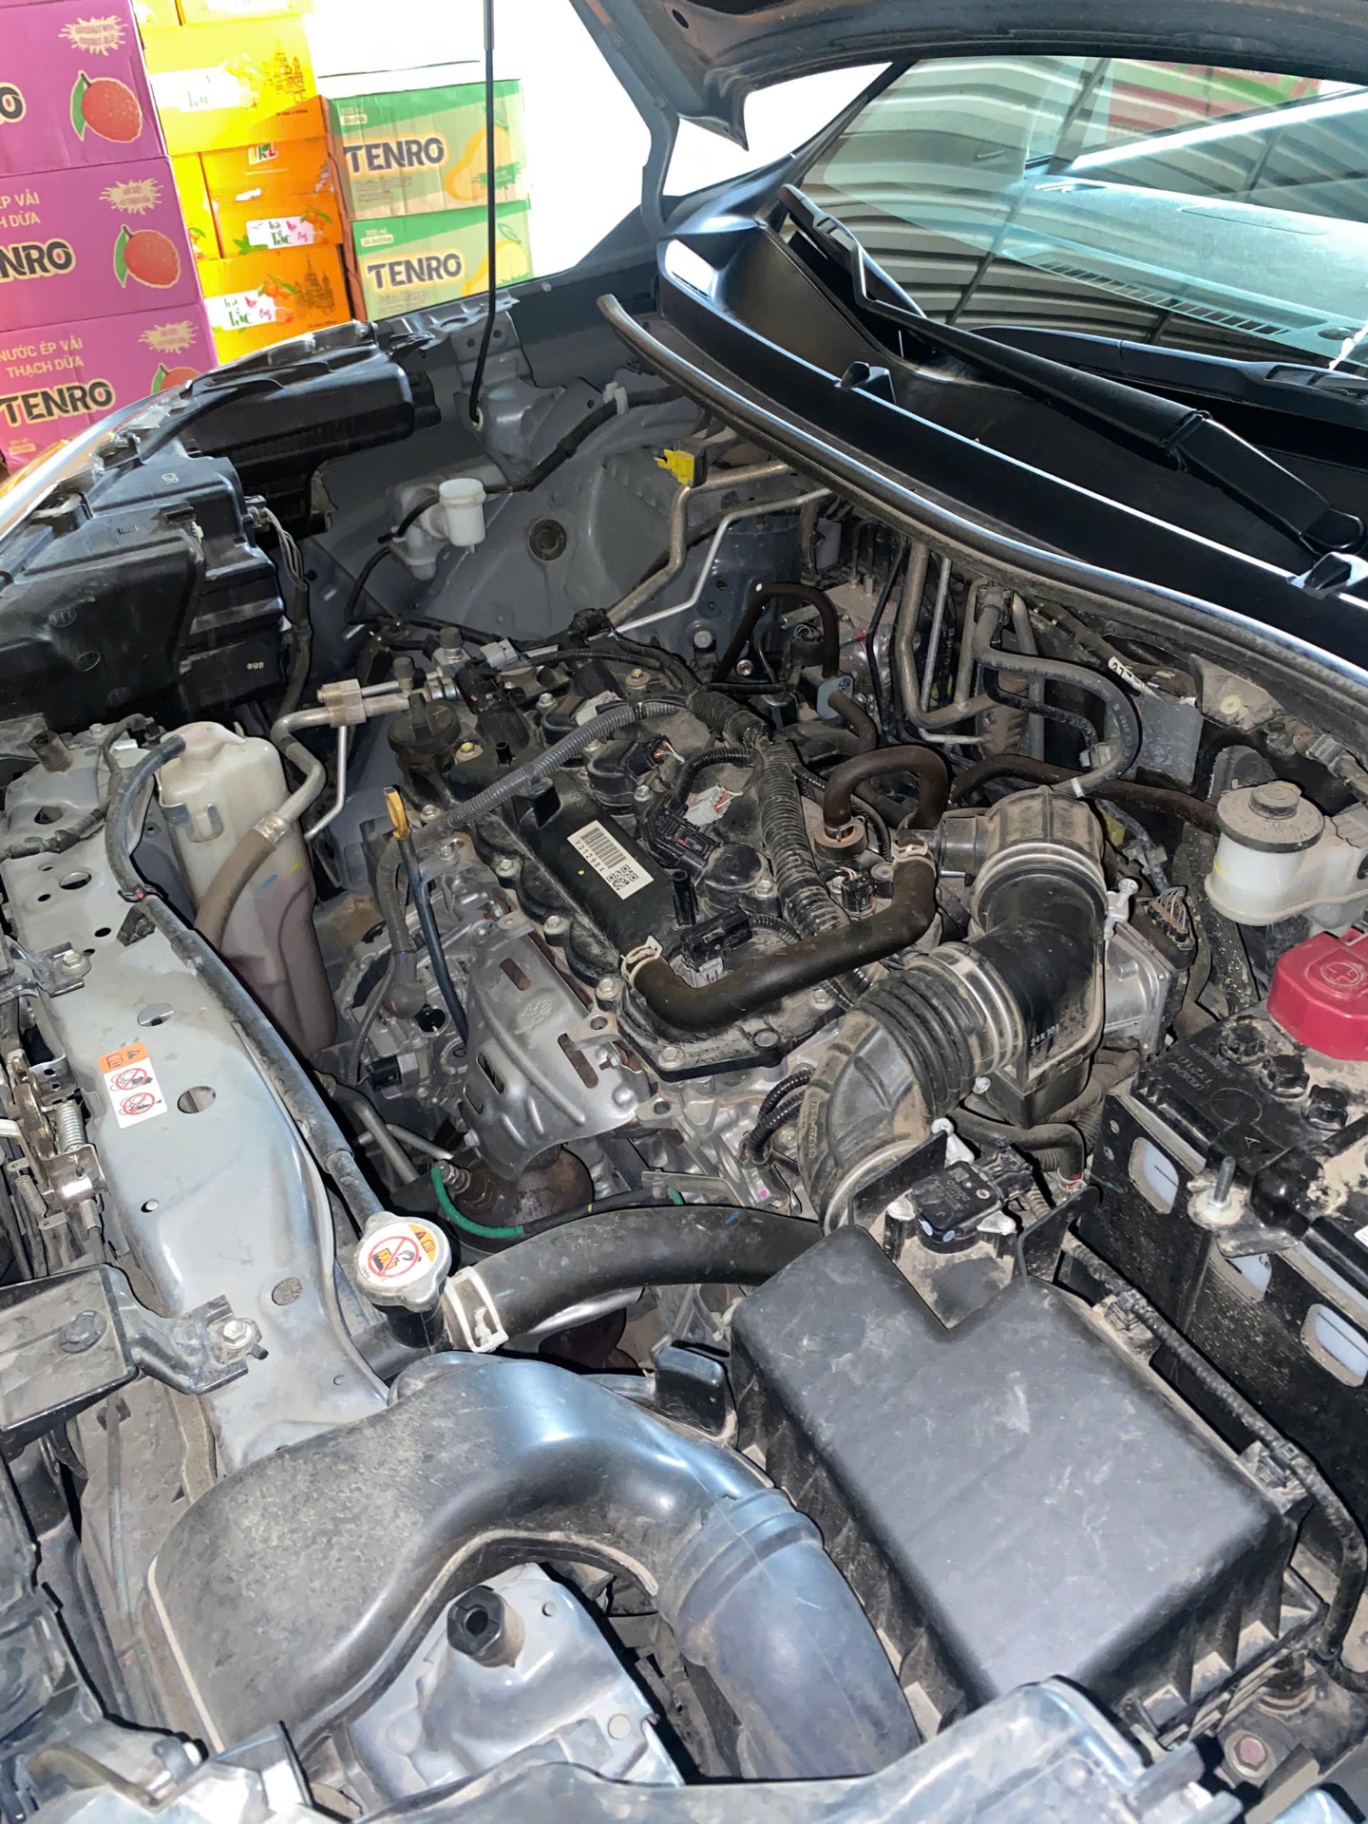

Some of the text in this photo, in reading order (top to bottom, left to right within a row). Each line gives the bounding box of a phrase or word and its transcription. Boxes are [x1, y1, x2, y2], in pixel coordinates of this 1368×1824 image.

[343, 137, 445, 173] TENRO
[367, 253, 462, 289] TENRO
[39, 340, 57, 355] ÉP
[5, 355, 85, 378] THẠCH DỪA
[0, 381, 113, 425] TENRO
